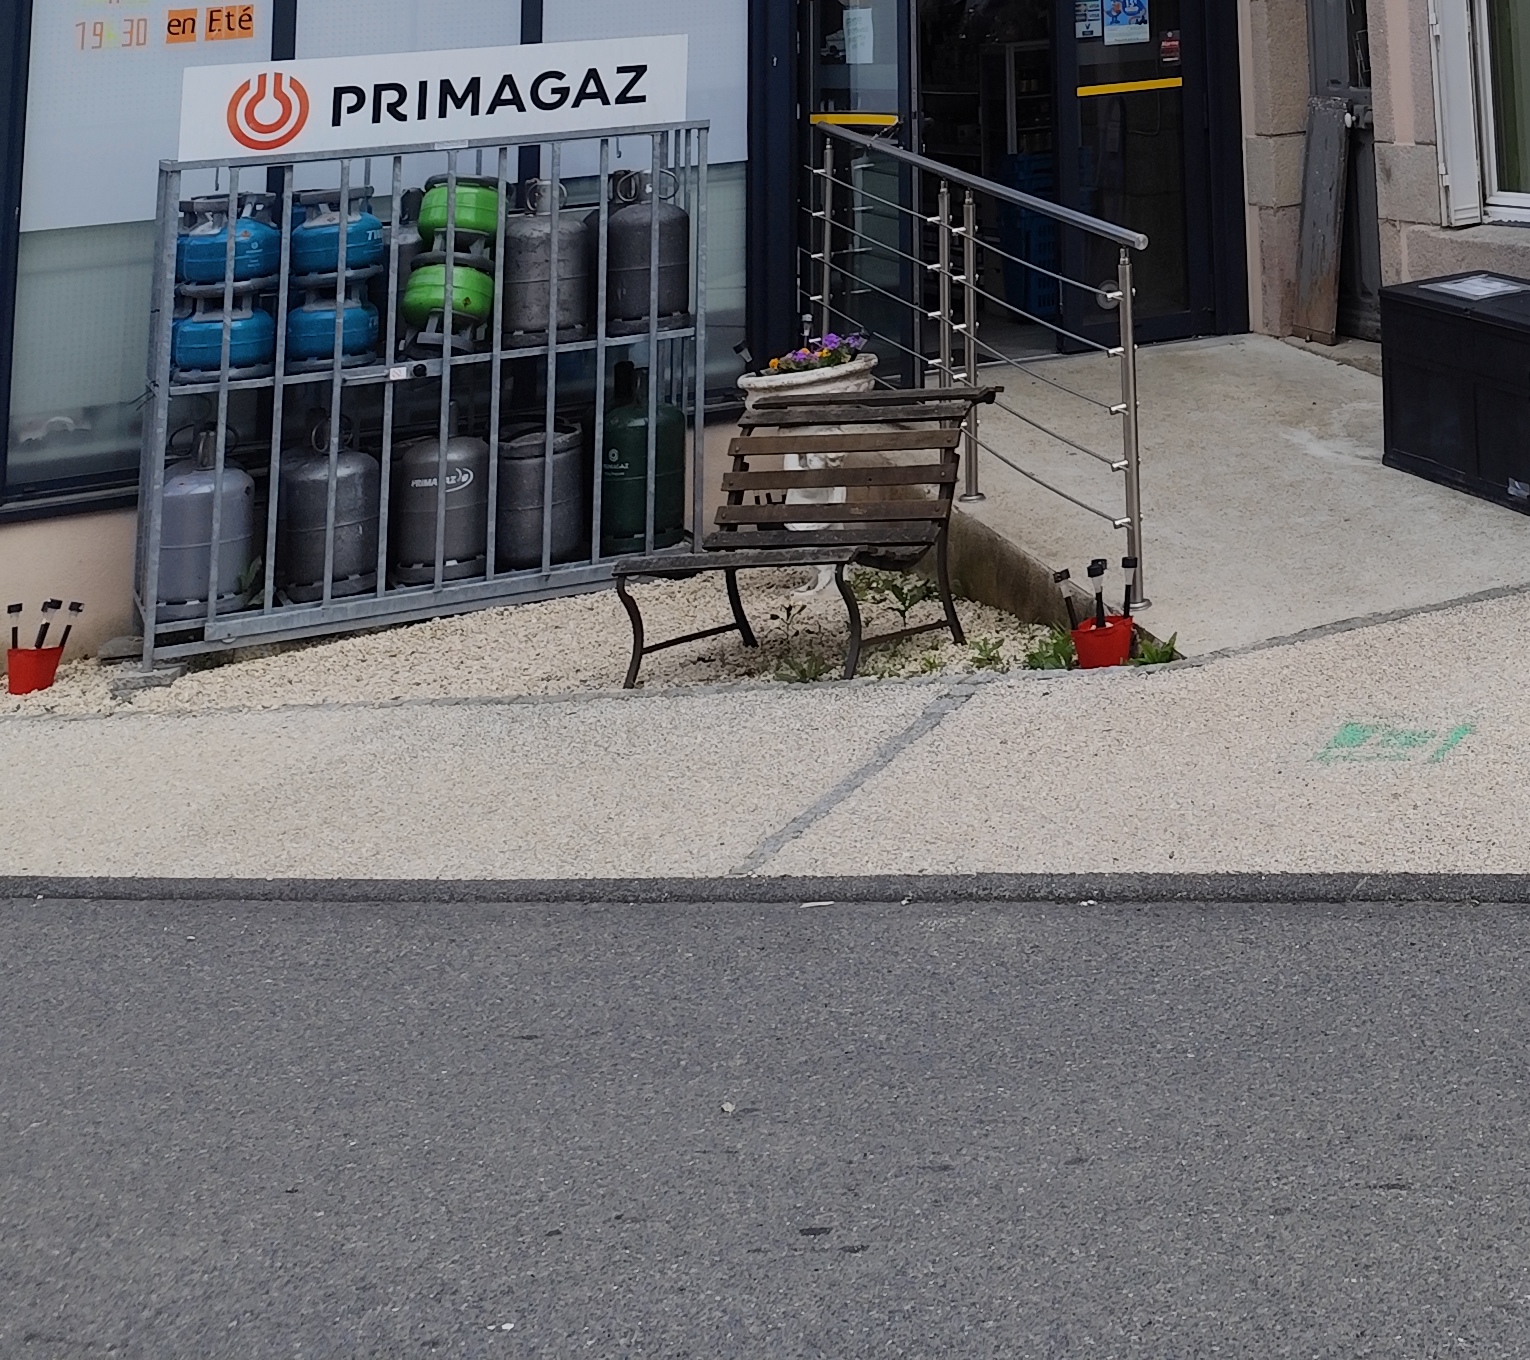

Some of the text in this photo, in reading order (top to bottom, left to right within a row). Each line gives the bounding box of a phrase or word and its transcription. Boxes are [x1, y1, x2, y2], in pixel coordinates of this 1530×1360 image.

[167, 16, 196, 36] en
[208, 7, 253, 33] Eté
[331, 64, 648, 127] PRIMAGAZ
[411, 475, 457, 488] PRIMAAZ
